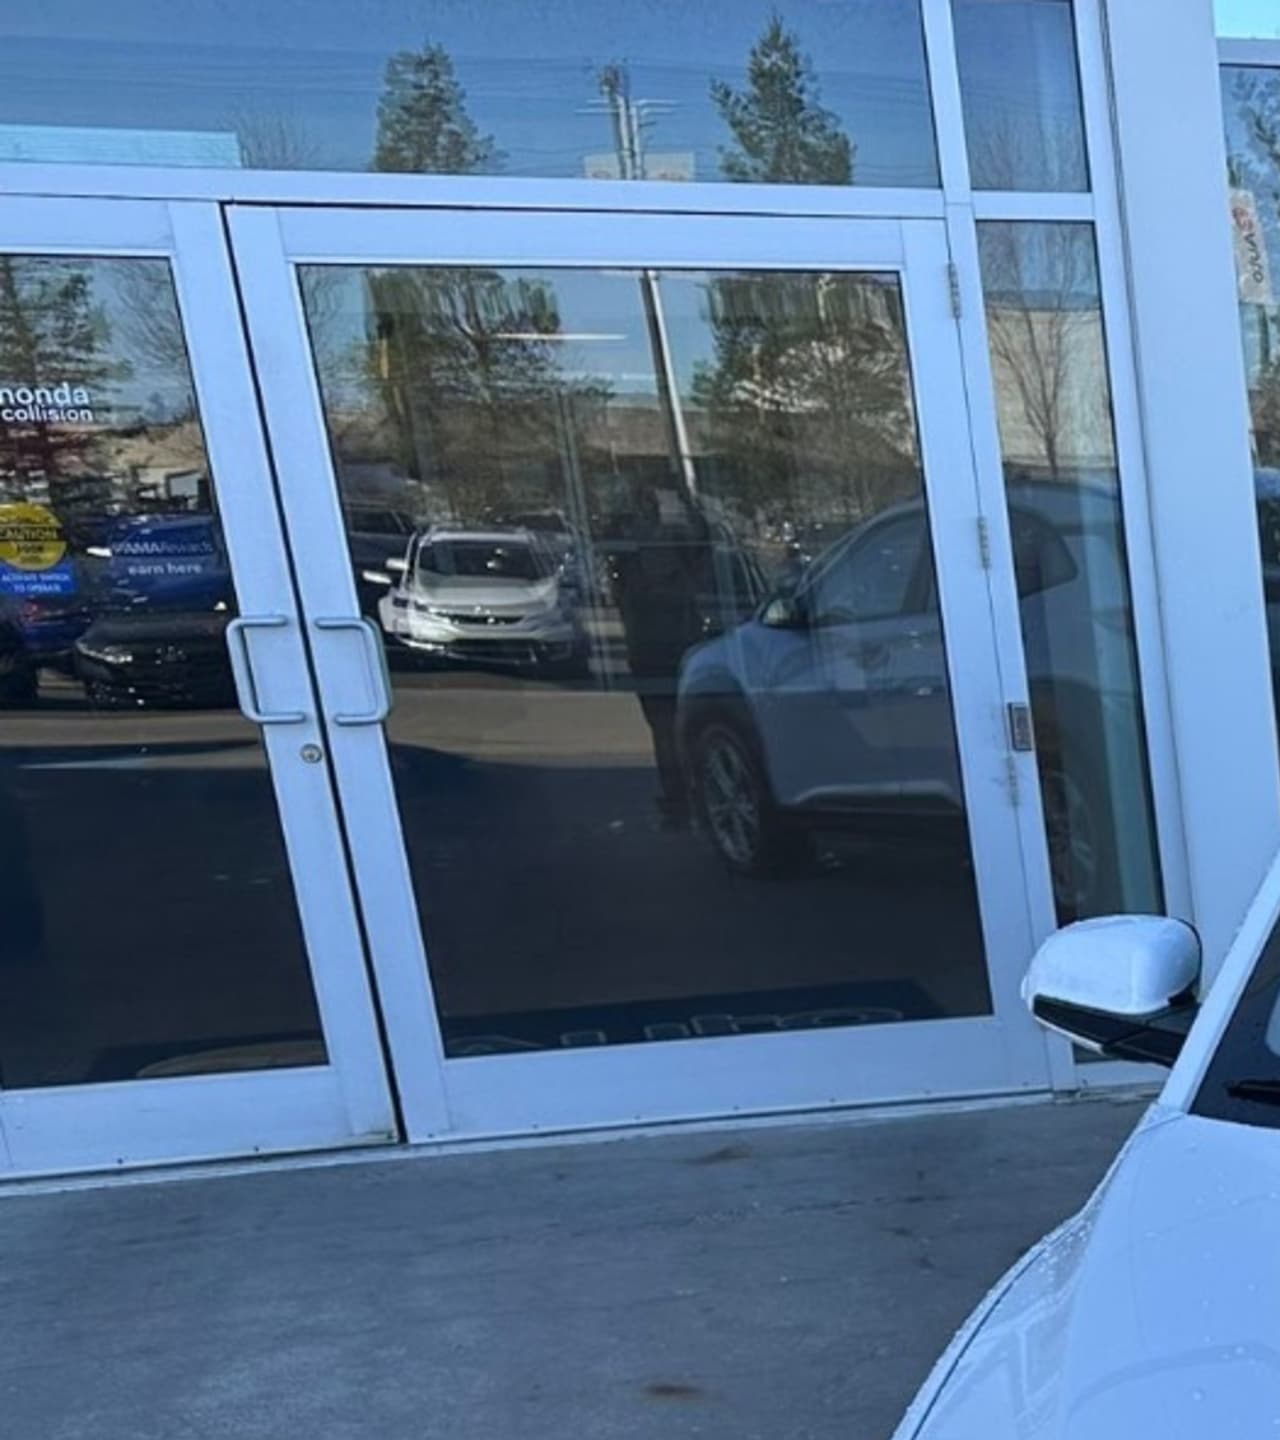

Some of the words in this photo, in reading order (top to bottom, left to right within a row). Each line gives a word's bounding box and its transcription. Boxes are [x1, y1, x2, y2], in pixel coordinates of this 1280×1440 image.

[1, 404, 94, 422] collision
[127, 564, 164, 575] earn
[166, 562, 202, 575] here
